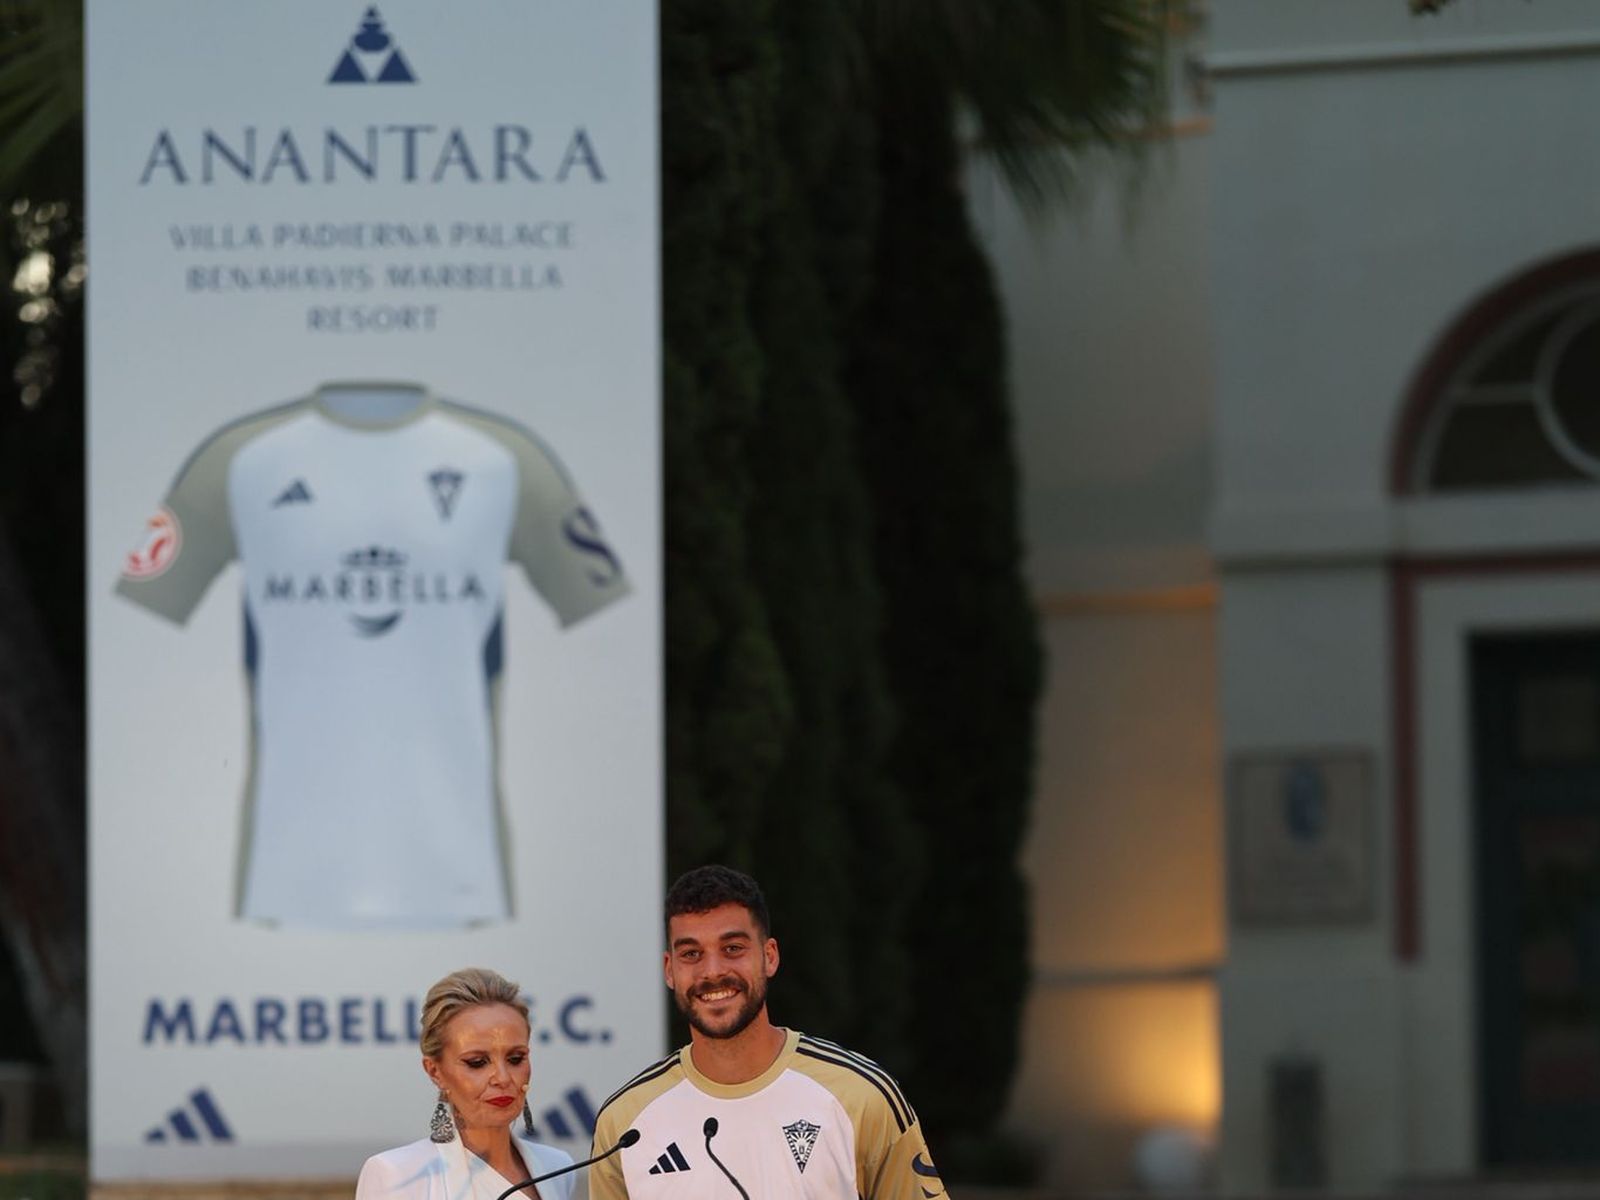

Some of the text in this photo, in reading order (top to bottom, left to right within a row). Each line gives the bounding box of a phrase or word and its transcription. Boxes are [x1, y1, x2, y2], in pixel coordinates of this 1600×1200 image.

[138, 124, 607, 186] ANANTARA
[168, 221, 573, 250] VILLA PADIERNA PALACE
[386, 264, 563, 290] MARBELLA
[307, 305, 439, 332] RESORT
[265, 572, 486, 602] MARBELLA
[142, 997, 423, 1044] MARBELL
